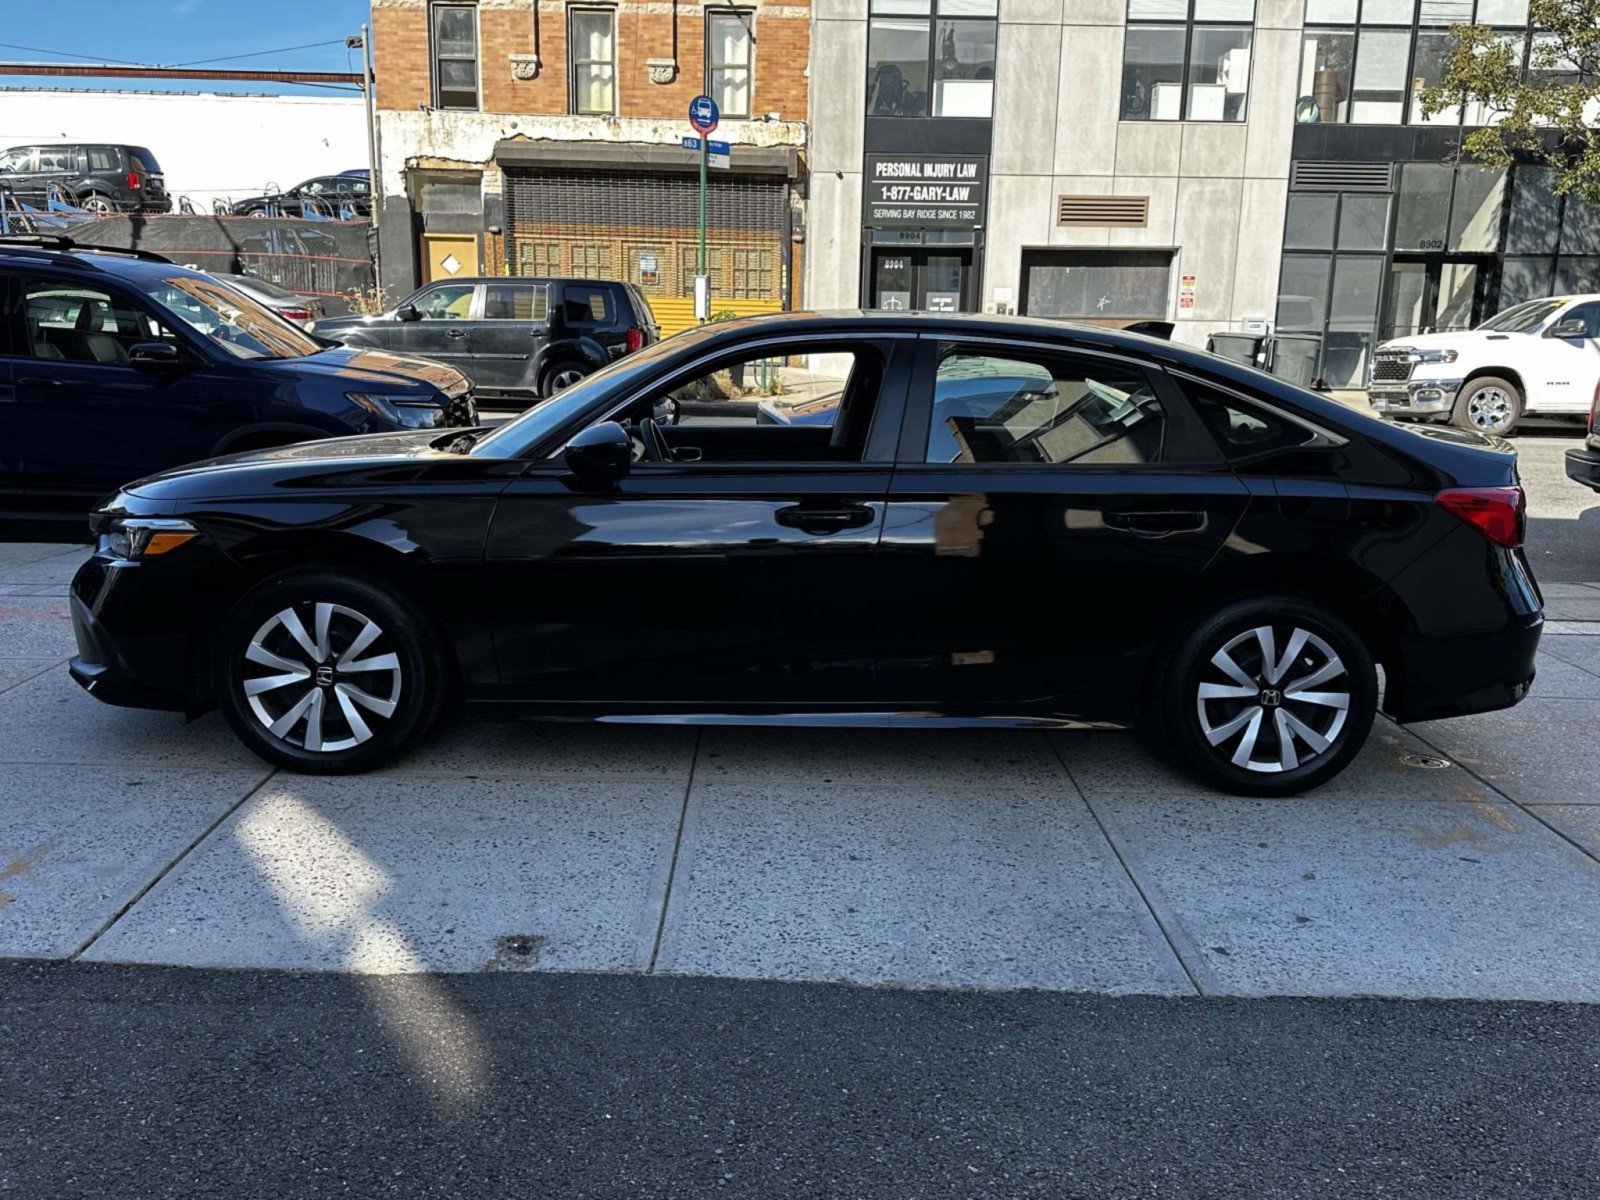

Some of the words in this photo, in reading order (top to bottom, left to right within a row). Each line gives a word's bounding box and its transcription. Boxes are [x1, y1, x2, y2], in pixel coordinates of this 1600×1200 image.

[683, 139, 697, 148] B63
[876, 162, 922, 177] PERSONAL
[924, 163, 956, 177] INJURY
[956, 164, 977, 178] LAW
[881, 186, 970, 201] 1-877-GARY-LAW
[874, 209, 901, 219] SERVING
[903, 209, 917, 219] BAY
[917, 209, 937, 219] RIDGE
[937, 210, 958, 219] SINCE
[959, 210, 975, 220] 1982
[899, 232, 920, 240] 8904
[1419, 239, 1443, 249] 8902
[884, 260, 904, 269] 8904
